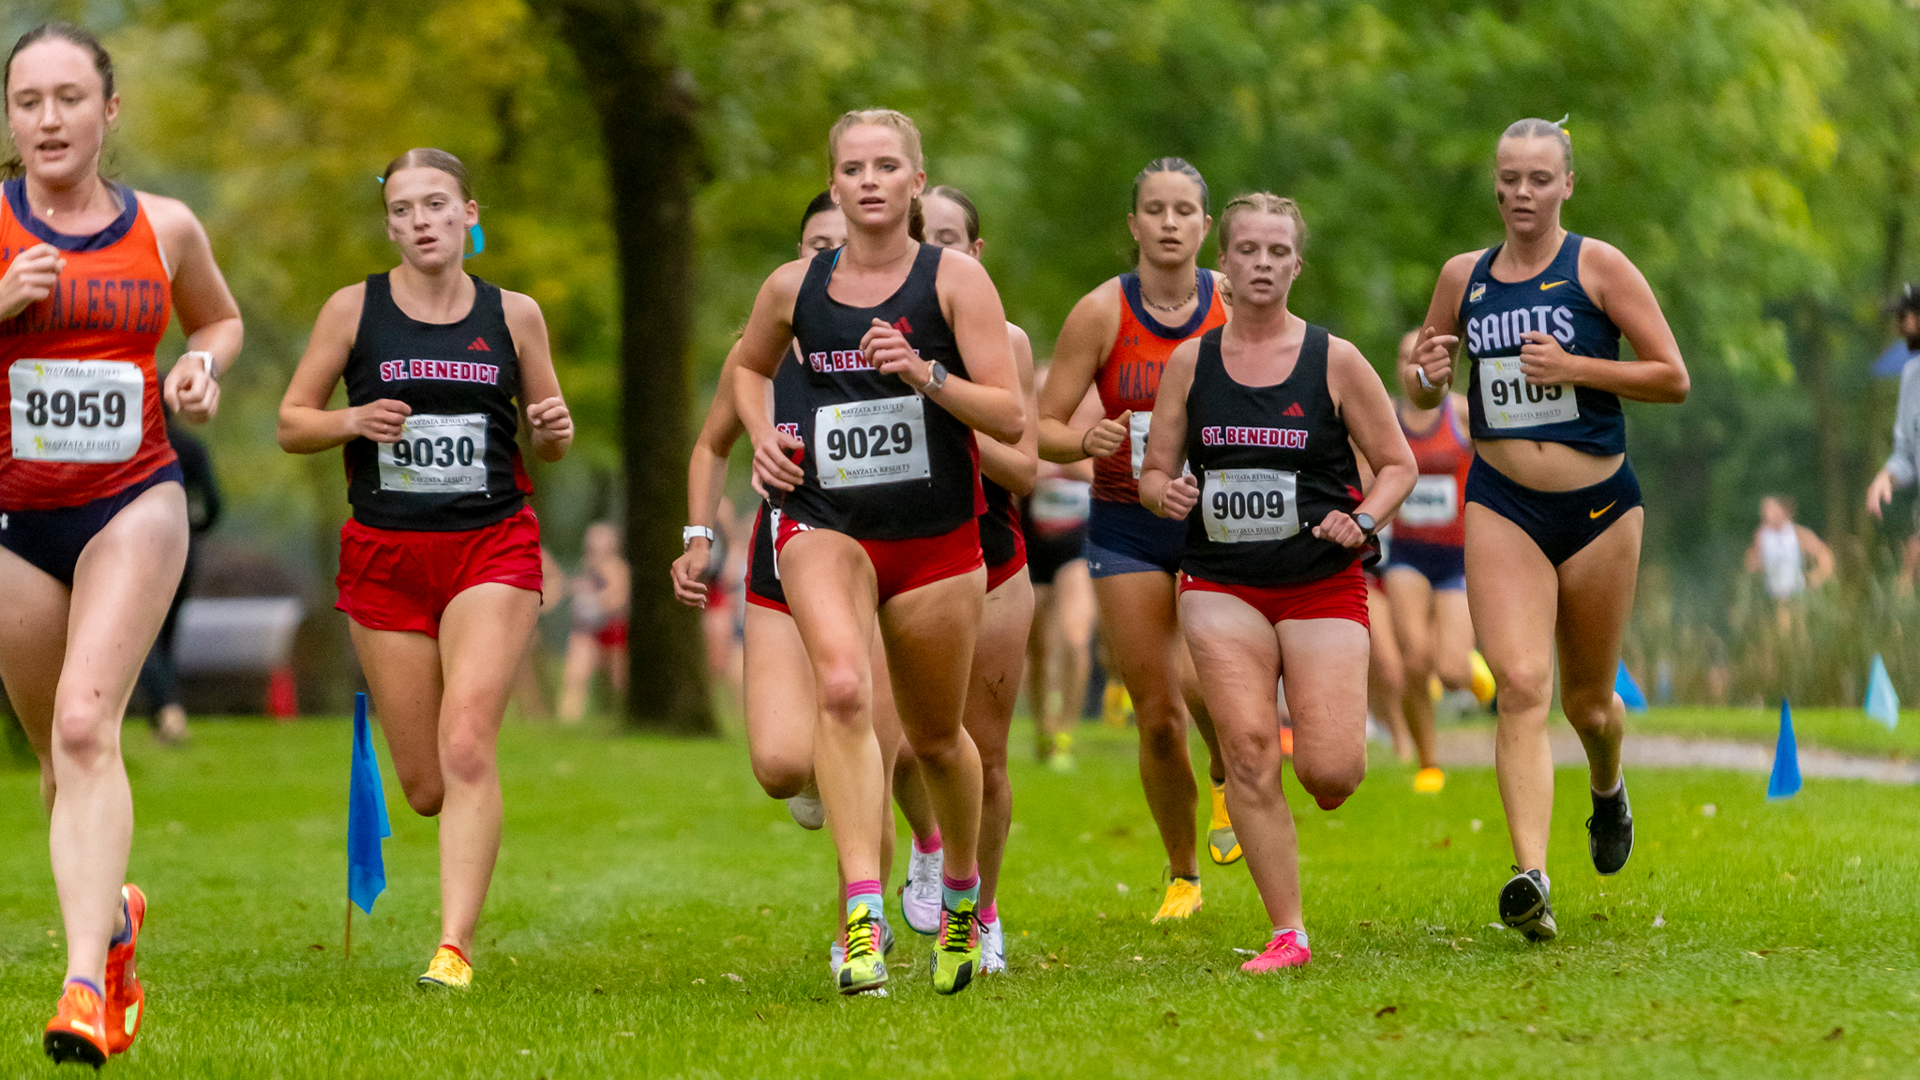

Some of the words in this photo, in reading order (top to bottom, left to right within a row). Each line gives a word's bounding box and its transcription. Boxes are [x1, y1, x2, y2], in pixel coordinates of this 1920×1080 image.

[1467, 305, 1575, 353] SAINTS
[380, 360, 409, 382] ST.
[410, 359, 499, 385] BENEDICT
[809, 351, 832, 373] ST.
[1491, 378, 1562, 406] 9105
[26, 389, 126, 428] 8959
[841, 407, 871, 415] WAYZATA
[873, 403, 904, 412] RESULTS
[393, 436, 474, 467] 9030
[827, 423, 912, 461] 9029
[1202, 426, 1224, 446] ST.
[1225, 426, 1308, 449] BENEDICT
[845, 468, 878, 476] WAYZATA
[879, 464, 911, 473] RESULTS
[1212, 490, 1285, 520] 9009
